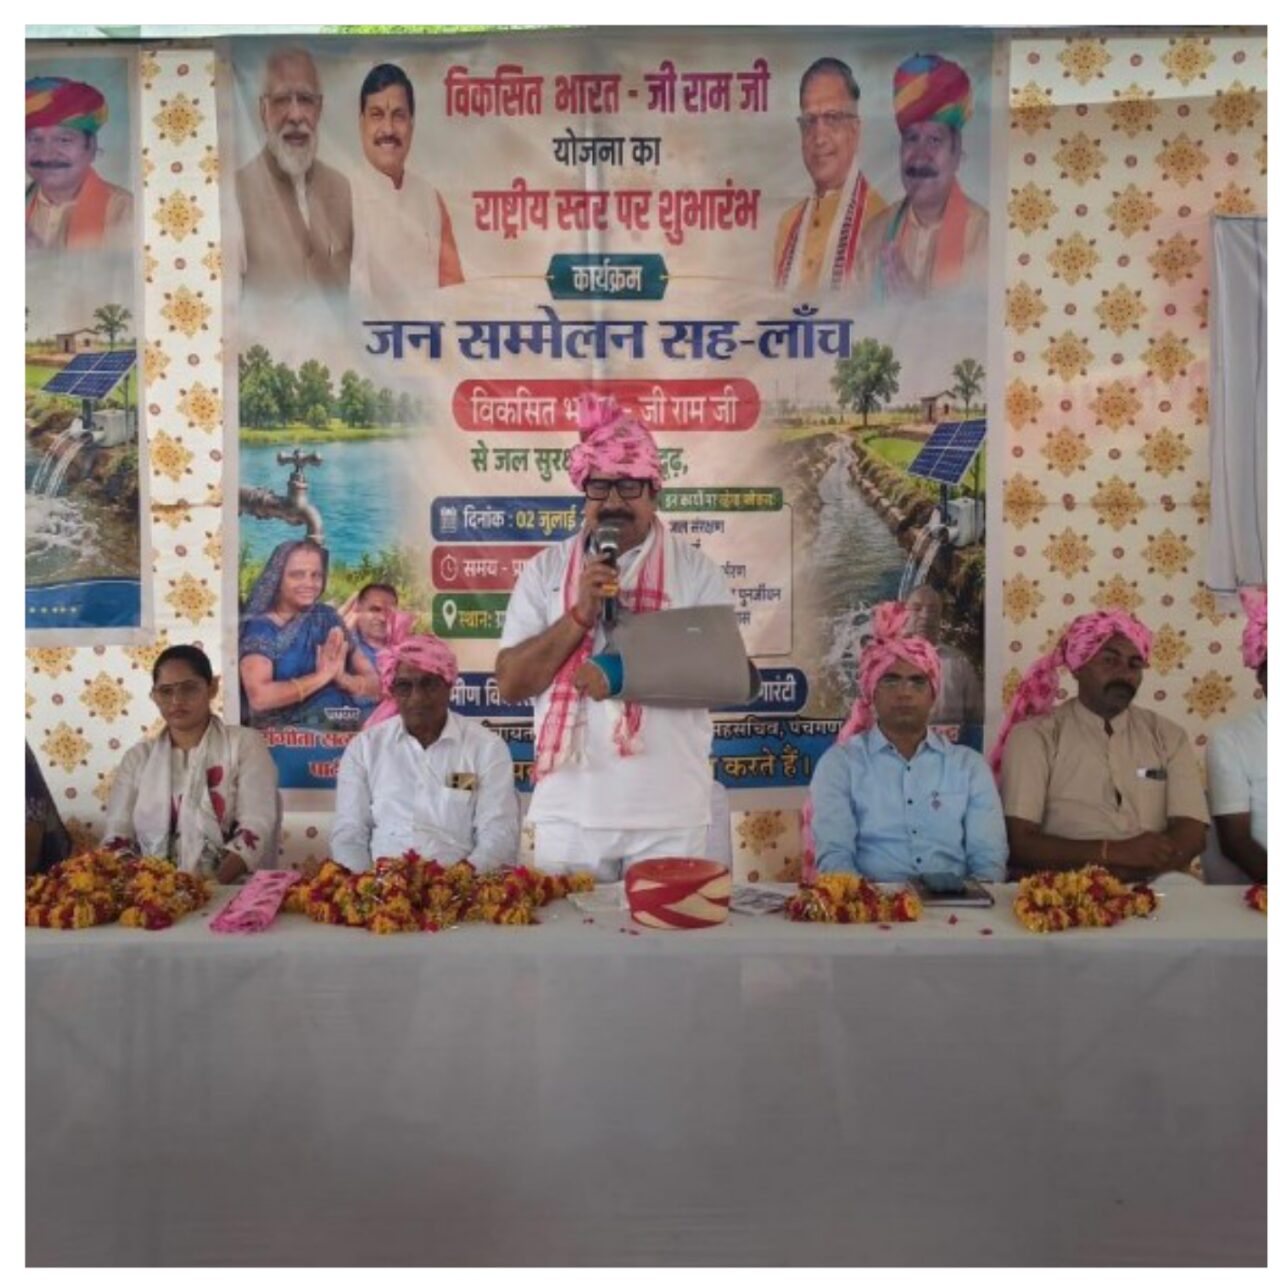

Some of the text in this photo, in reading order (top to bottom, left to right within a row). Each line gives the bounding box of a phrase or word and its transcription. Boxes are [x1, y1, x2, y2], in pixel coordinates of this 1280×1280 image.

[444, 65, 544, 117] विकसित
[554, 73, 621, 114] भारत
[644, 60, 677, 113] जी
[681, 72, 733, 113] राम
[736, 58, 770, 112] जी
[553, 128, 661, 166] योजना का
[472, 177, 761, 246] राष्ट्रीय स्तर पर शुभारंभ
[571, 258, 643, 293] कार्यक्रम
[363, 320, 445, 361] जन
[455, 305, 648, 361] सम्मेलन
[470, 386, 557, 424] विकसित
[639, 386, 668, 424] जी
[671, 396, 705, 423] राम
[709, 386, 739, 424] जी
[470, 440, 488, 471] से
[493, 448, 529, 471] जल
[463, 504, 505, 528] दिनांक
[515, 511, 534, 527] 02
[538, 505, 577, 535] जुलाई
[463, 558, 498, 577] समय
